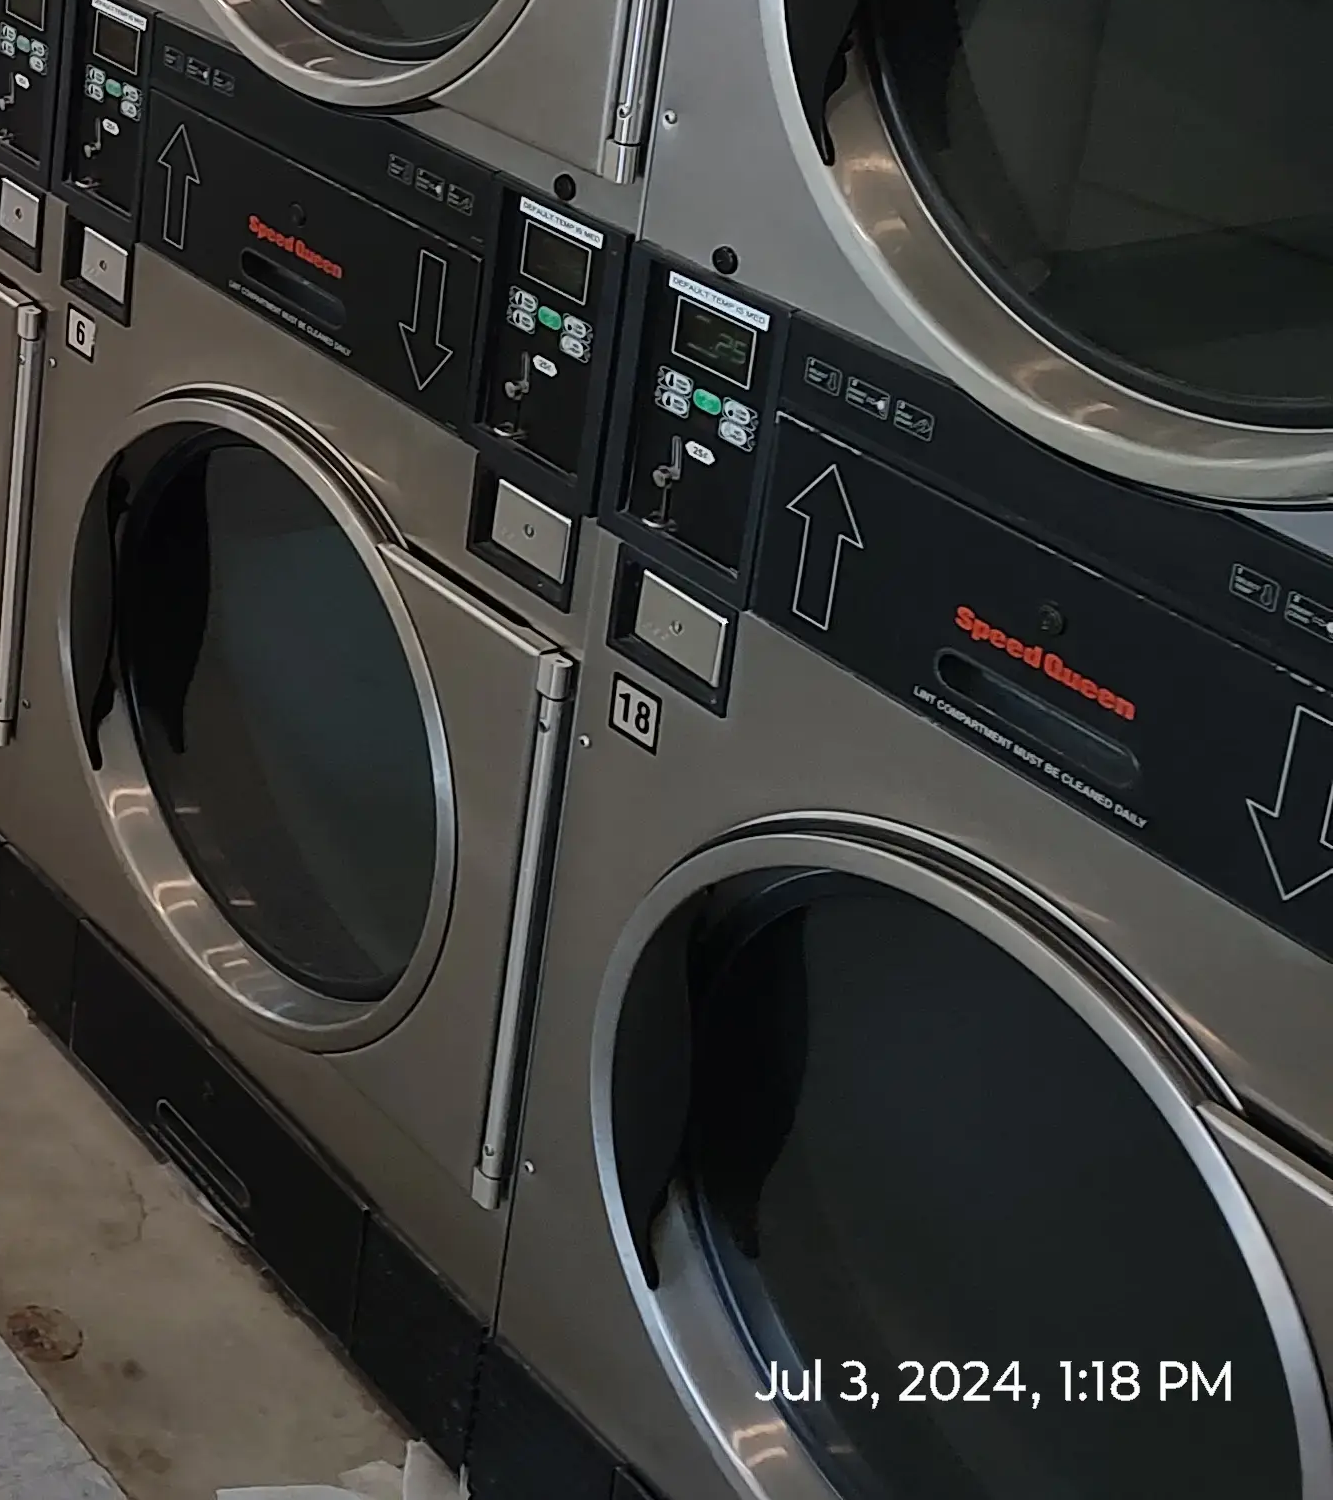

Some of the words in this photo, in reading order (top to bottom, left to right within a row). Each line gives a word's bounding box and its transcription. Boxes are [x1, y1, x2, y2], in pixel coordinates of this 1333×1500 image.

[523, 200, 555, 222] DEFAULT
[555, 215, 576, 231] TEMP
[584, 229, 601, 243] MED
[249, 215, 295, 253] Speed
[295, 239, 342, 279] Queen
[672, 276, 710, 299] DEFAULT
[712, 293, 735, 310] TEMP
[747, 310, 766, 326] MED
[76, 320, 85, 346] 6
[954, 605, 1043, 669] Speed
[1043, 652, 1137, 721] Queen
[618, 692, 651, 735] 18
[912, 685, 937, 706] LINT
[937, 699, 1013, 751] COMPARTMENT
[1013, 743, 1045, 769] MUST
[1044, 762, 1060, 780] BE
[1060, 772, 1114, 811] CLEANED
[1114, 803, 1149, 830] DAILY
